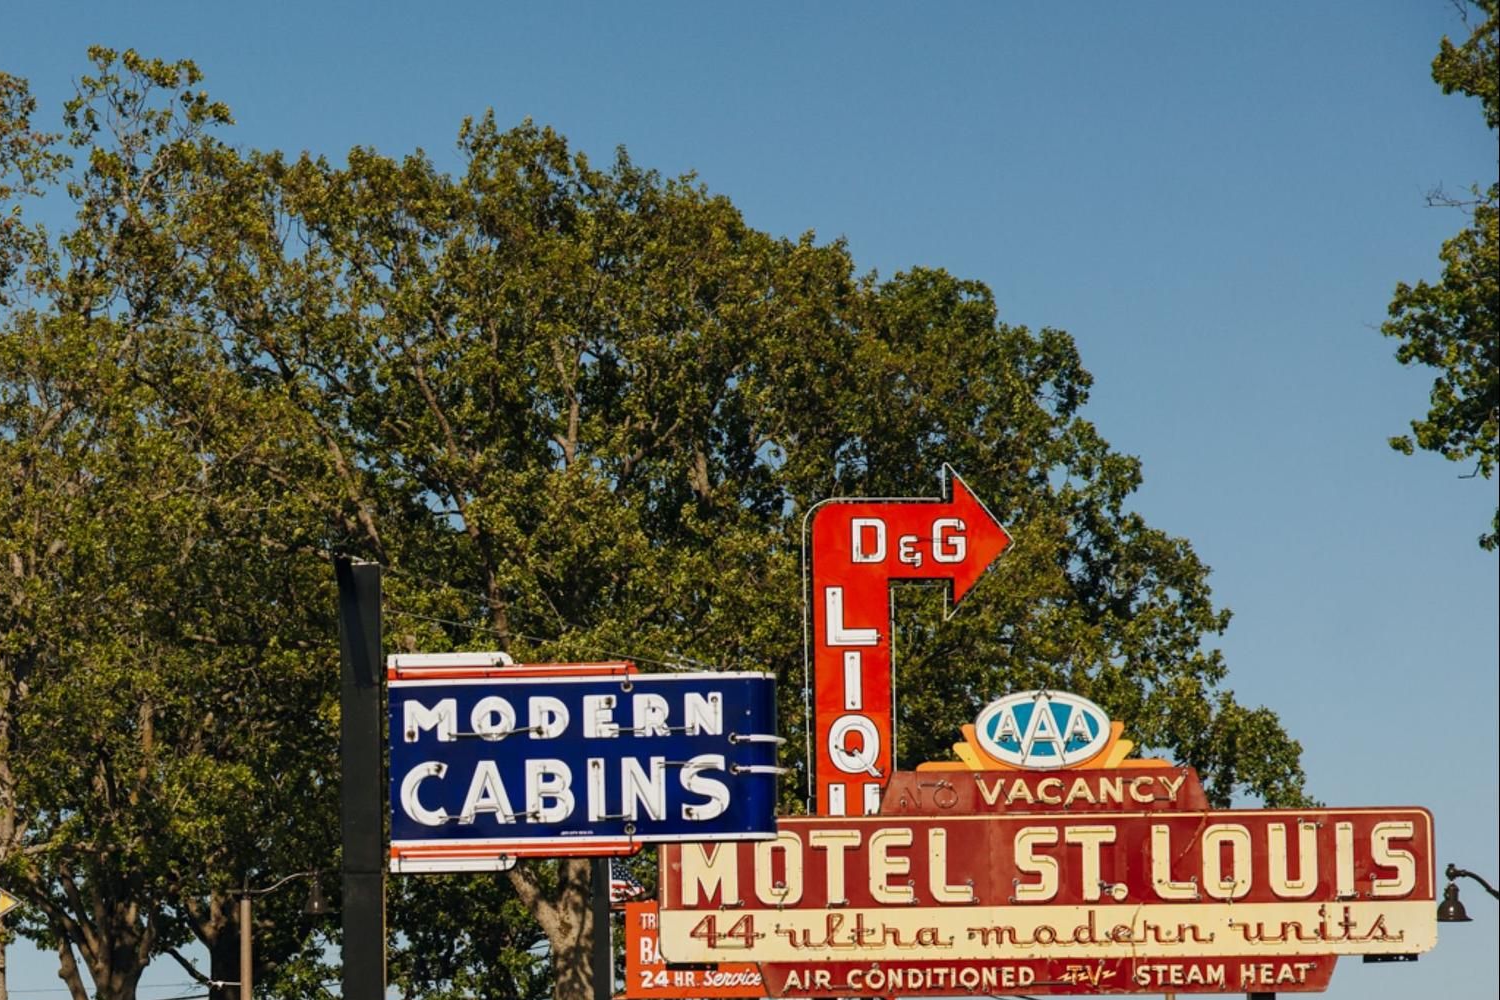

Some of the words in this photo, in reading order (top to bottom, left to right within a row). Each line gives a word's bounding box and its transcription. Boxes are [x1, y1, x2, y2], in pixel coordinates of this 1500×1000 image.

[403, 691, 723, 743] MODERN
[993, 694, 1094, 765] AAA
[400, 754, 731, 827] CABINS
[976, 774, 1188, 807] VACANCY
[681, 827, 976, 906] MOTEL
[1014, 825, 1129, 902] ST.
[1151, 820, 1416, 900] LOUIS
[640, 912, 658, 930] TR
[690, 913, 755, 949] 44
[776, 913, 954, 950] ultra
[968, 909, 1214, 947] modern
[1229, 904, 1404, 944] units
[640, 970, 669, 988] 24
[703, 969, 762, 988] Service
[784, 968, 832, 991] AIR
[847, 967, 1035, 990] CONDITIONED
[1066, 964, 1102, 986] TV
[1136, 964, 1225, 987] STEAM
[1241, 963, 1313, 986] HEAT
